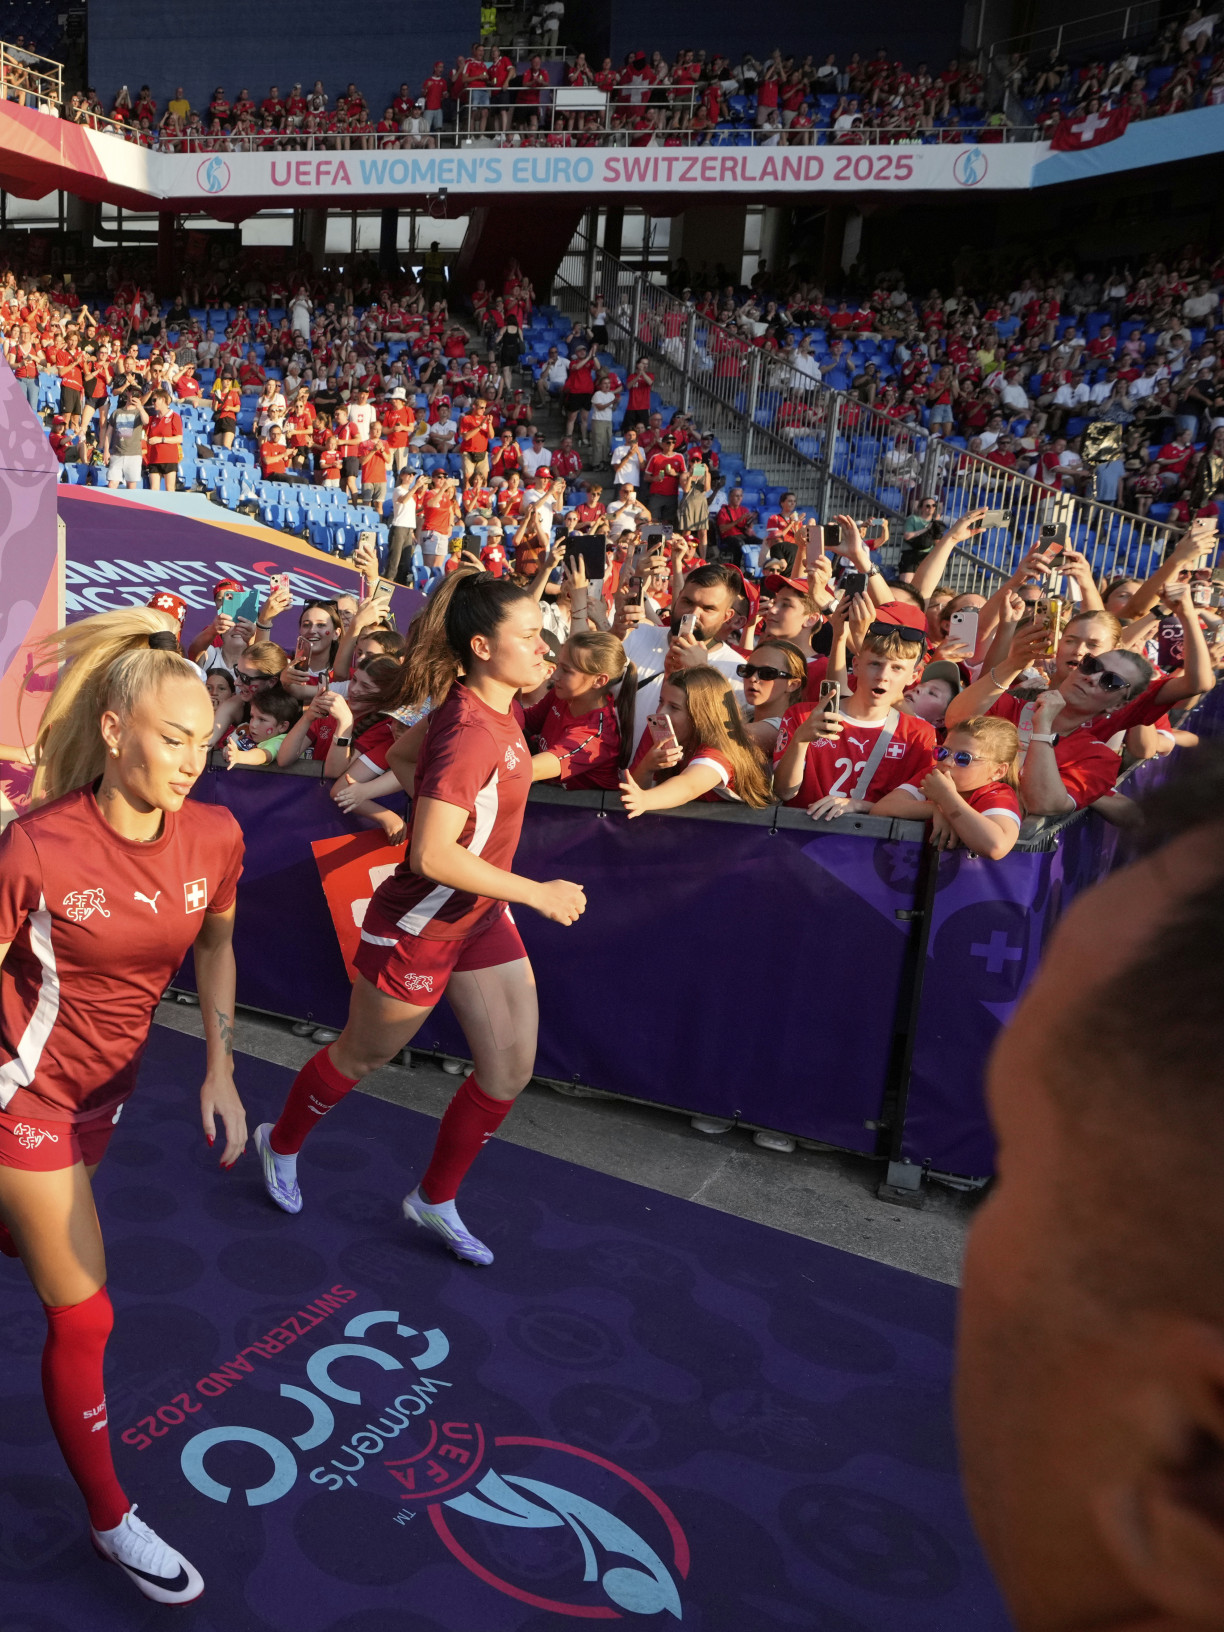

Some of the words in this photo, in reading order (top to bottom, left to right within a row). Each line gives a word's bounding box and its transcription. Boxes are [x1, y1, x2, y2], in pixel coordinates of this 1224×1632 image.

[270, 160, 352, 186] UEFA
[360, 157, 502, 185] WOMEN'S
[512, 156, 594, 184] EURO
[603, 154, 824, 183] SWITZERLAND
[833, 153, 914, 181] 2025
[195, 1284, 358, 1397] SWITZERLAND
[121, 1392, 203, 1451] 2025
[309, 1376, 454, 1491] women's
[387, 1421, 473, 1490] UEFA
